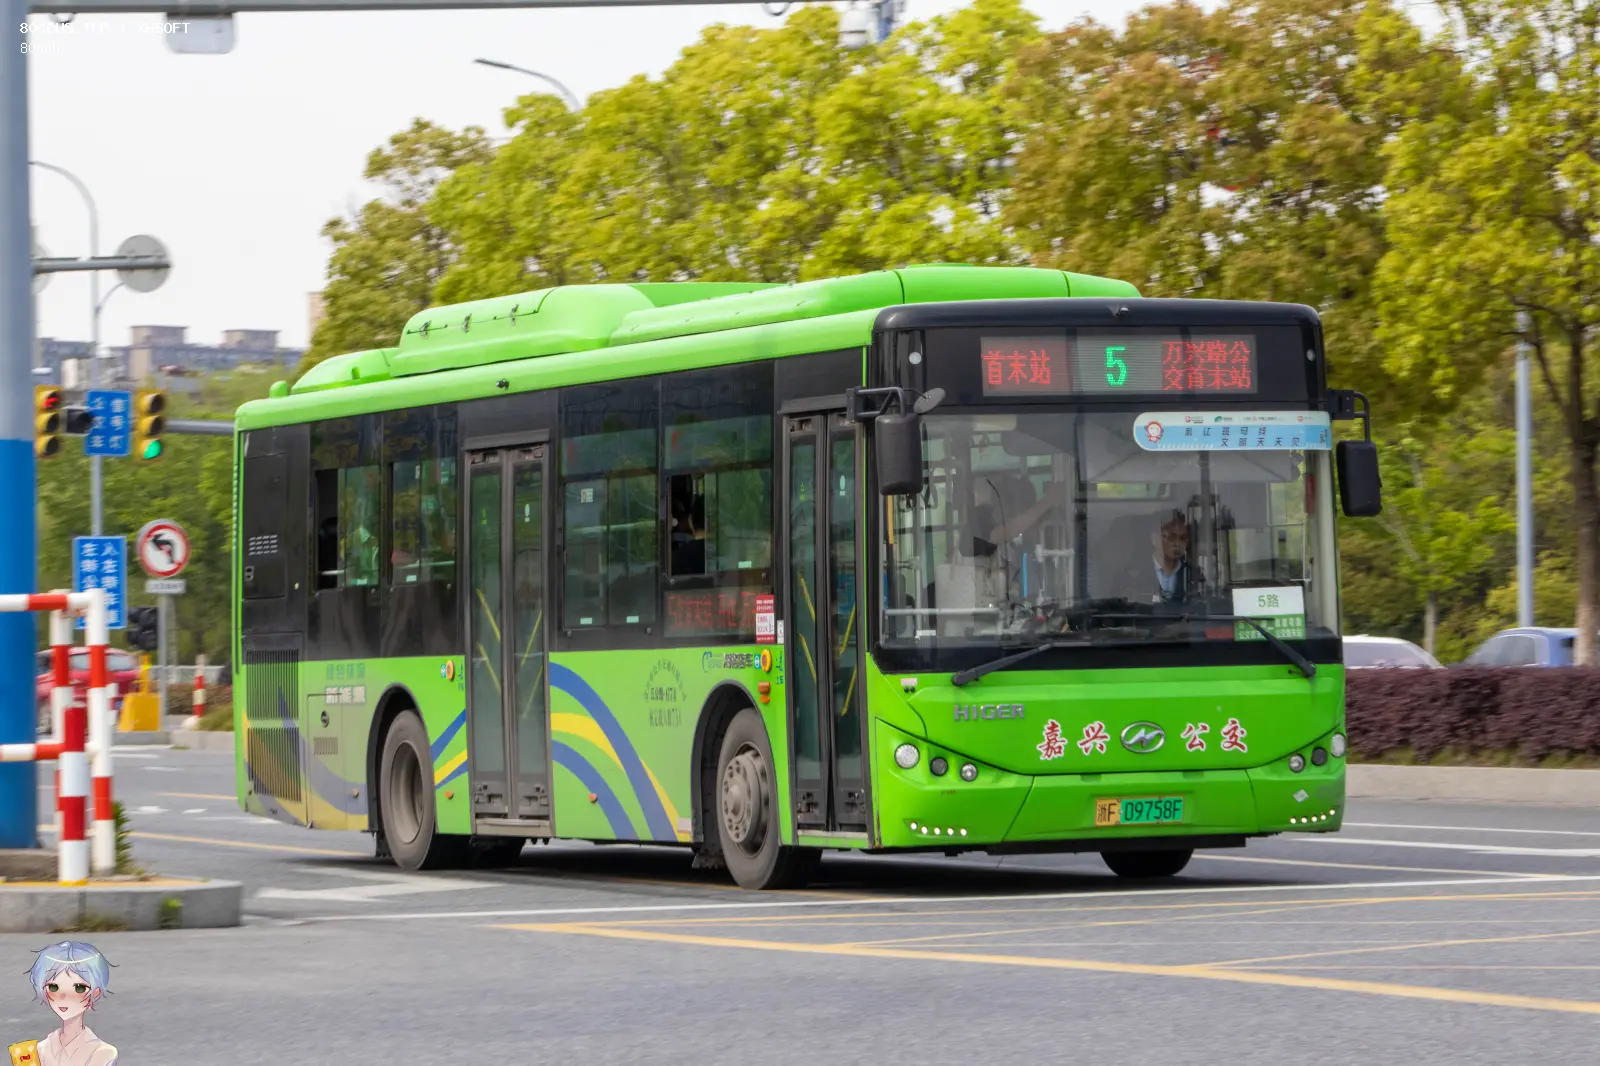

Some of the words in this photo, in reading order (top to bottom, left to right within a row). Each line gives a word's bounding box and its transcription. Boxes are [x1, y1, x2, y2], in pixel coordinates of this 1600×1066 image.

[983, 350, 1051, 385] 首末站
[1106, 346, 1127, 387] 5
[1163, 365, 1252, 391] 交首末站
[1258, 594, 1280, 608] 5路
[953, 703, 1025, 721] HIGER
[1037, 719, 1110, 760] 嘉兴
[1181, 718, 1248, 752] 公交
[1124, 799, 1182, 822] 09758F
